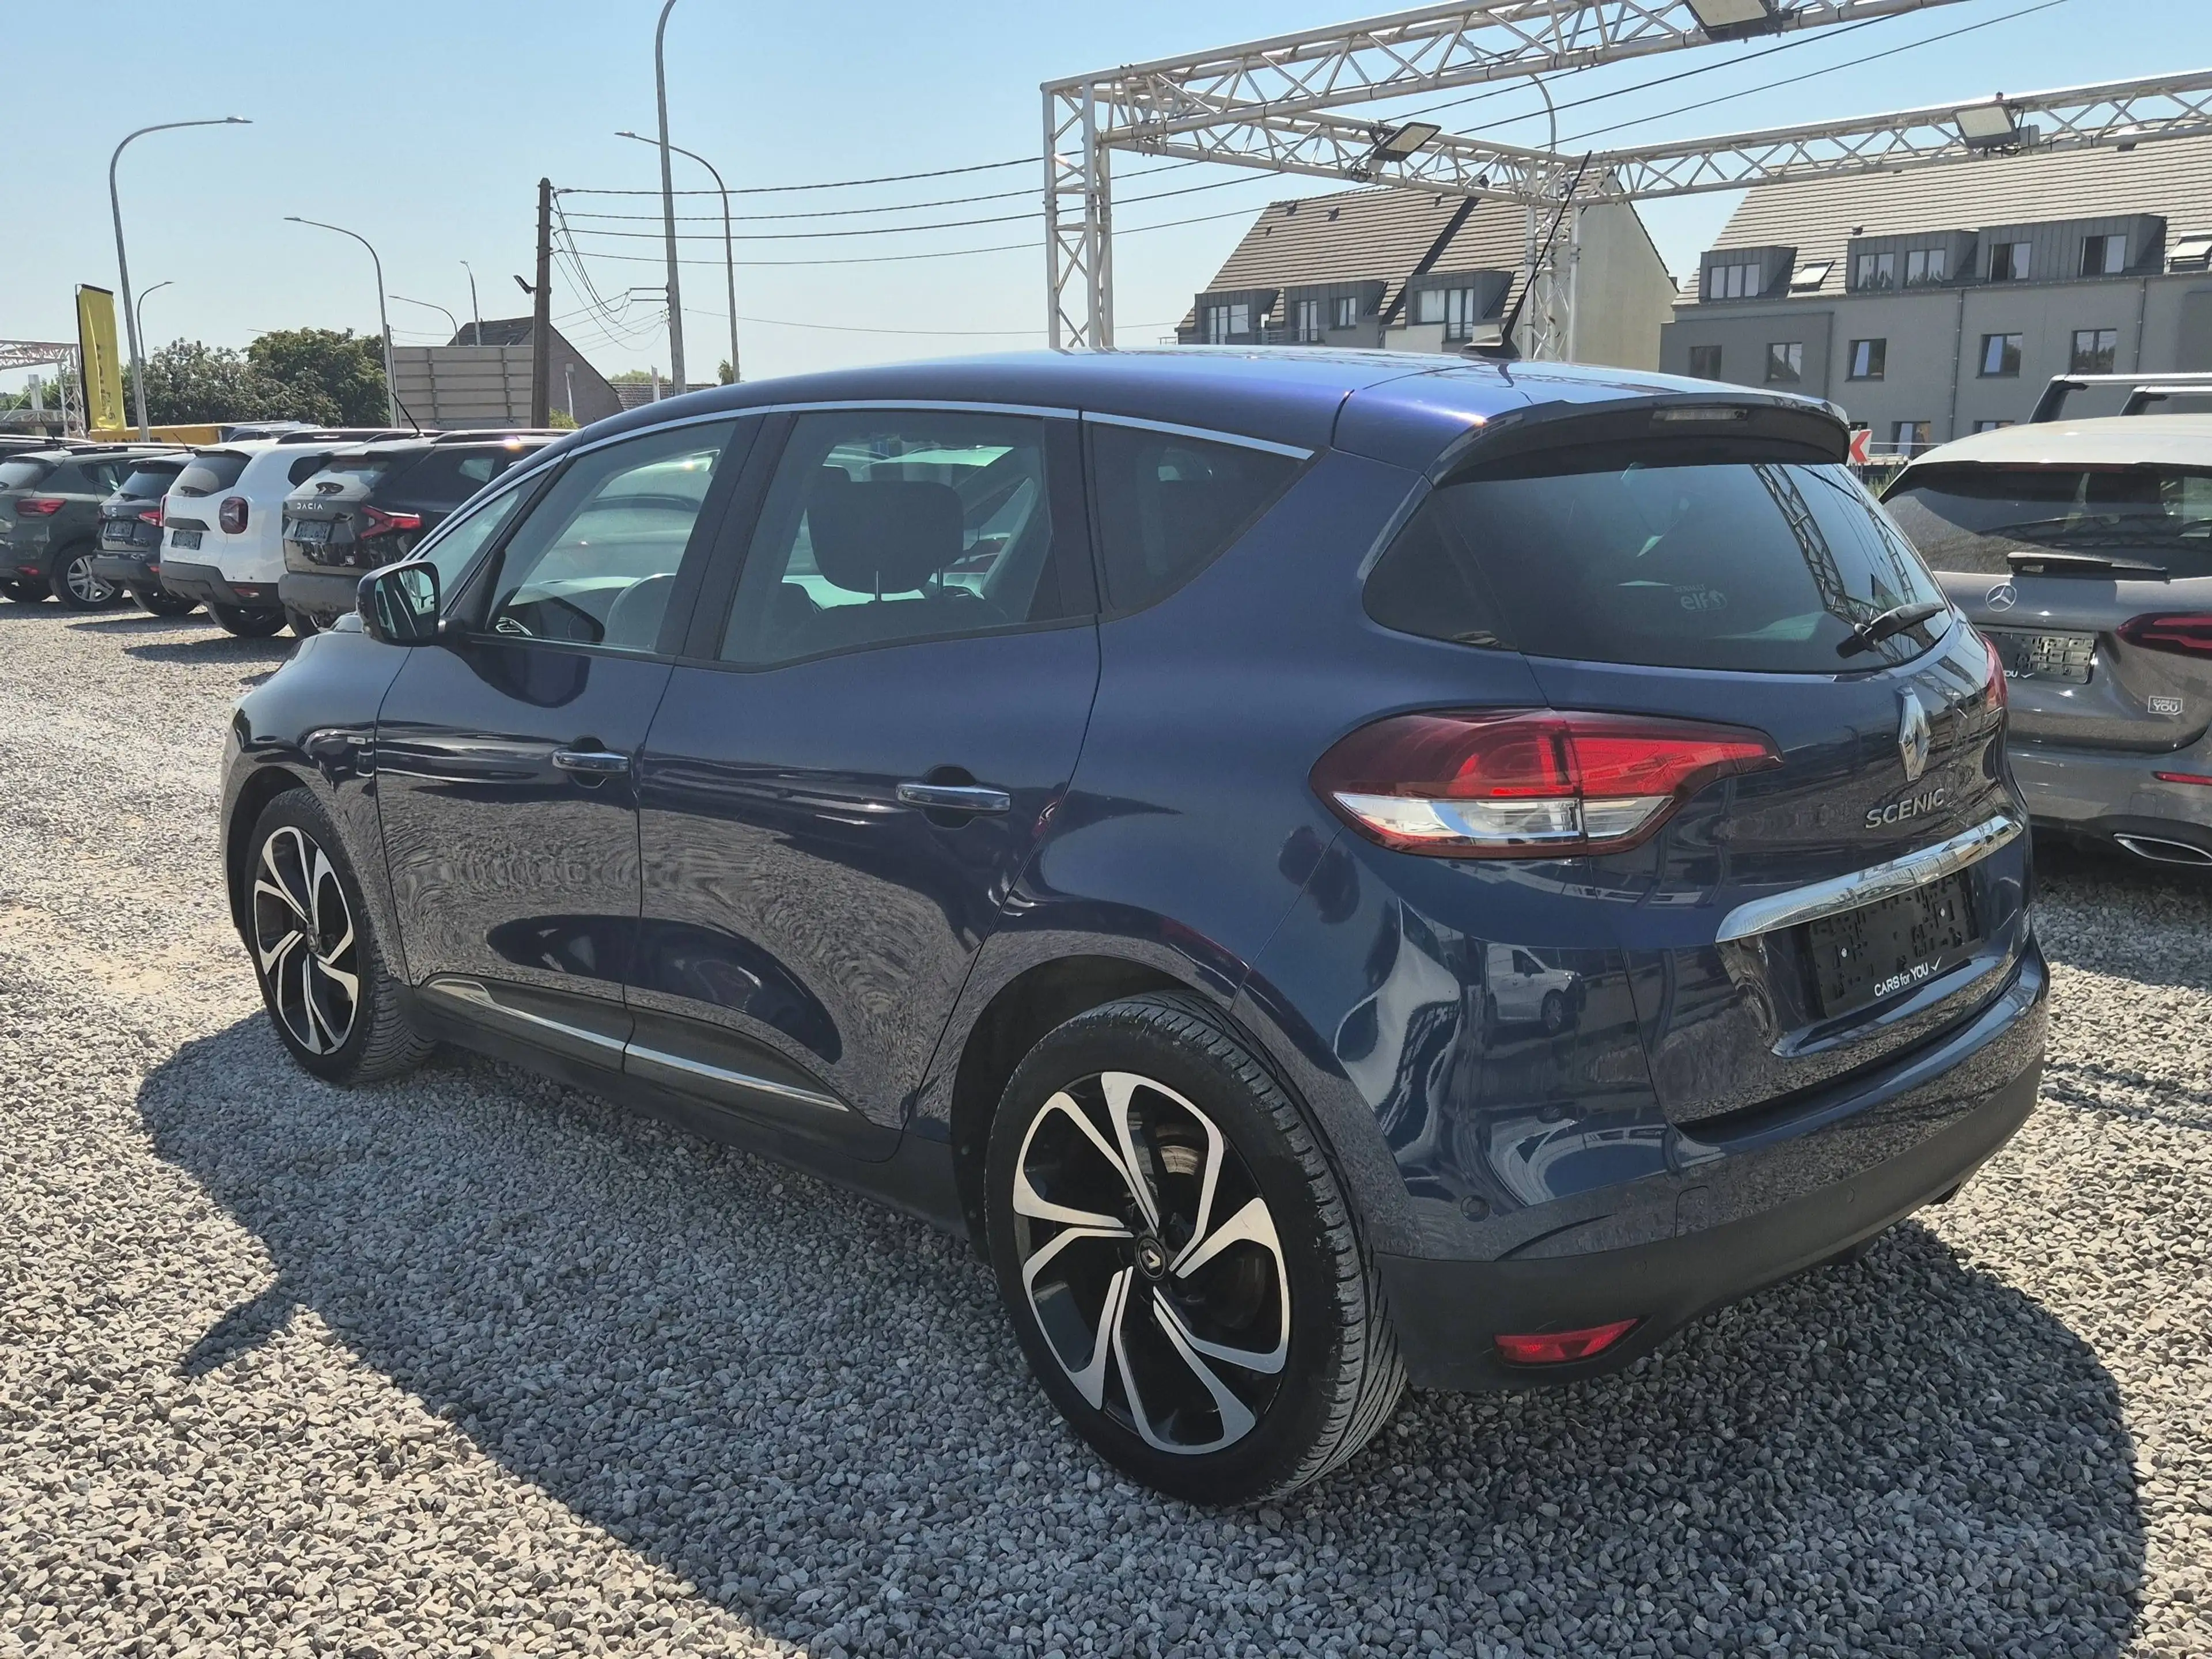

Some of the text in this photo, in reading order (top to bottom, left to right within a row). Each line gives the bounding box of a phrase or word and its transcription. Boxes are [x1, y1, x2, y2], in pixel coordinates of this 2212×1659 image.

[1680, 592, 1708, 610] elf
[2153, 701, 2177, 712] YOU
[1865, 788, 1945, 828] SCENIC
[1874, 961, 1929, 997] CARS for YOU
